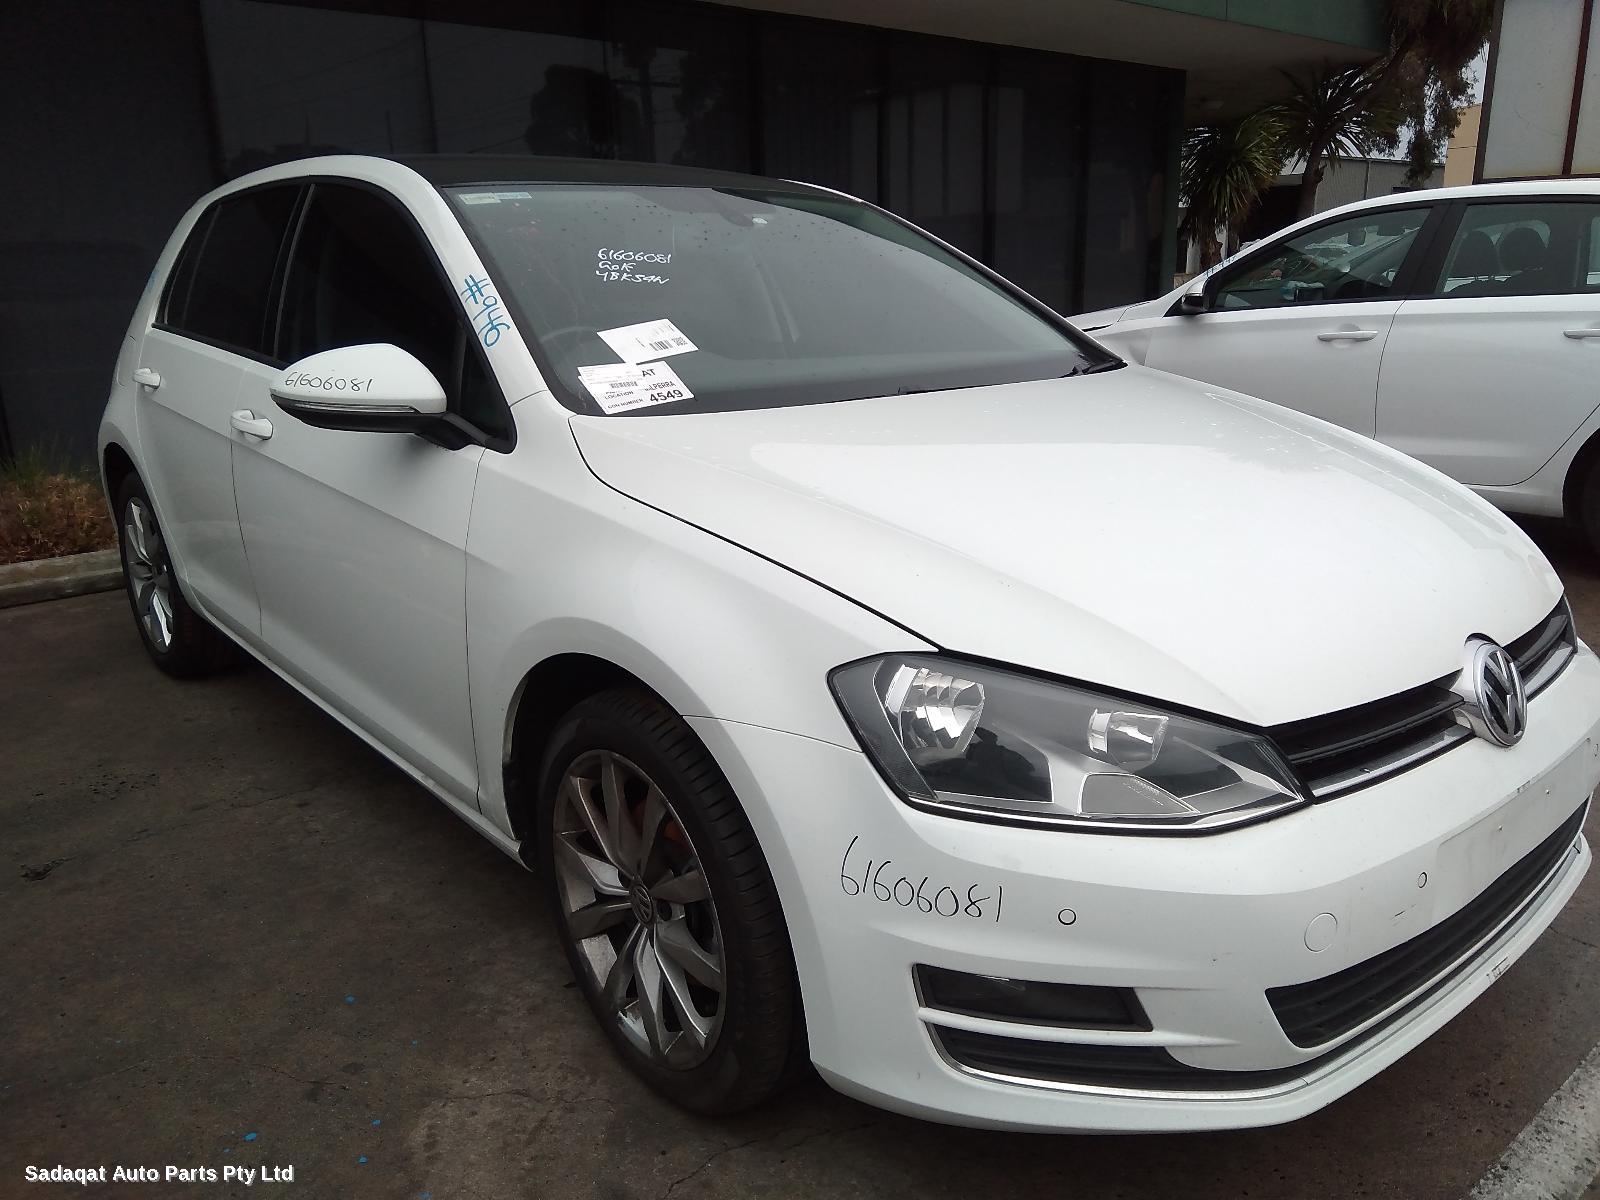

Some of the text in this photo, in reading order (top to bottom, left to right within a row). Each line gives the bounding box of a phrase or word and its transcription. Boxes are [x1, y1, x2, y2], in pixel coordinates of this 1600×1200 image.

[597, 248, 671, 264] 61606081
[285, 371, 373, 392] 61606081
[649, 389, 684, 403] 4549
[841, 835, 1002, 923] 61606081
